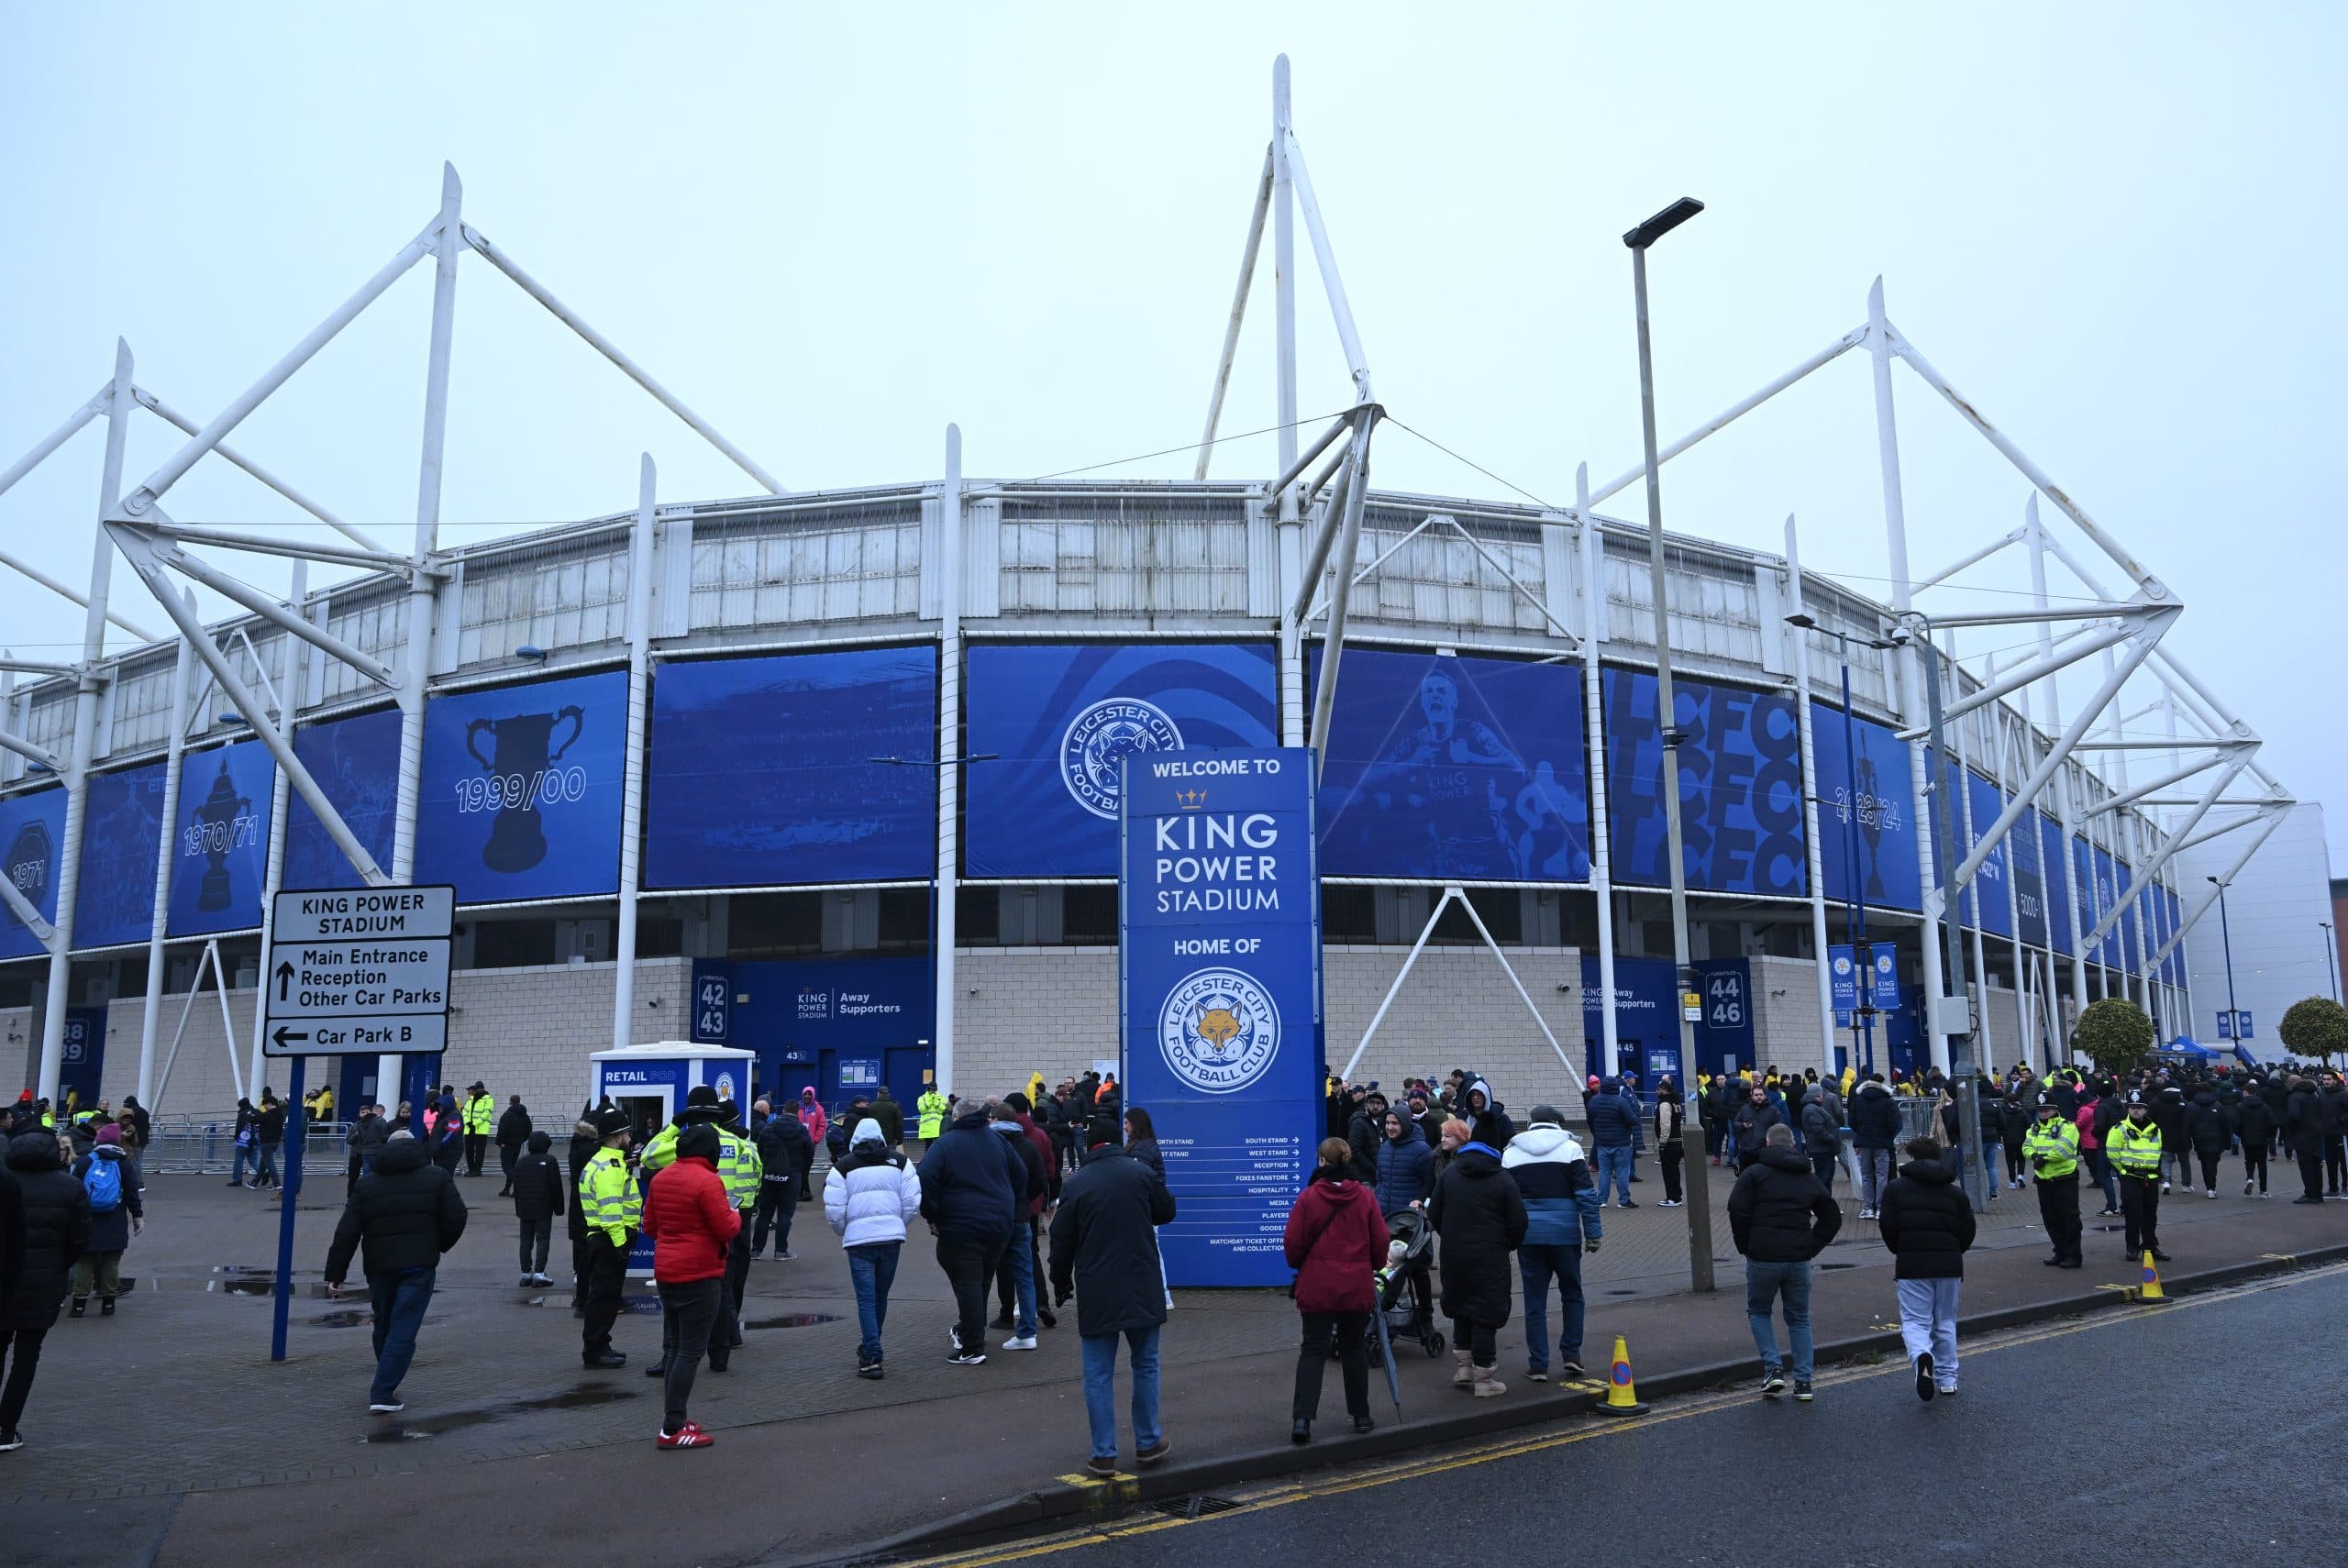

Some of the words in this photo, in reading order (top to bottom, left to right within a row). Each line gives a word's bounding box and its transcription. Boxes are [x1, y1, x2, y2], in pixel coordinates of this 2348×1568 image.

[1070, 705, 1150, 754] LEICESTER
[1150, 718, 1176, 752] CITY
[1153, 760, 1249, 778] WELCOME
[1254, 759, 1280, 774] TO
[455, 766, 586, 812] 1999/00
[1069, 763, 1118, 812] FOOTB
[184, 815, 258, 856] 1970/71
[1156, 813, 1278, 852] KING
[13, 859, 45, 889] 1971
[1157, 856, 1278, 883] POWER
[302, 898, 349, 914] KING
[356, 894, 425, 912] POWER
[1157, 888, 1280, 913] STADIUM
[318, 916, 404, 934] STADIUM
[1174, 939, 1231, 955] HOME
[1235, 938, 1261, 954] OF
[303, 950, 343, 966] Main
[350, 948, 428, 964] Entrance
[301, 969, 387, 988] Reception
[1711, 977, 1740, 999] 44
[299, 991, 349, 1007] Other
[355, 989, 385, 1005] Car
[393, 988, 441, 1004] Parks
[702, 984, 725, 1005] 42
[798, 993, 827, 1003] KING
[840, 993, 869, 1003] Away
[1169, 977, 1245, 1027] LEICESTER
[1245, 990, 1270, 1025] CITY
[840, 1004, 901, 1015] Supporters
[1614, 999, 1656, 1010] Supporters
[1712, 1002, 1741, 1022] 46
[701, 1011, 724, 1033] 43
[316, 1030, 347, 1045] Car
[354, 1028, 393, 1043] Park
[401, 1027, 412, 1042] B
[786, 1052, 798, 1060] 43
[1624, 1043, 1634, 1052] 45
[1168, 1036, 1241, 1083] FOOTBALL
[1241, 1033, 1269, 1074] CLUB
[605, 1071, 648, 1082] RETAIL
[650, 1071, 676, 1081] POD
[719, 1146, 735, 1157] ICE
